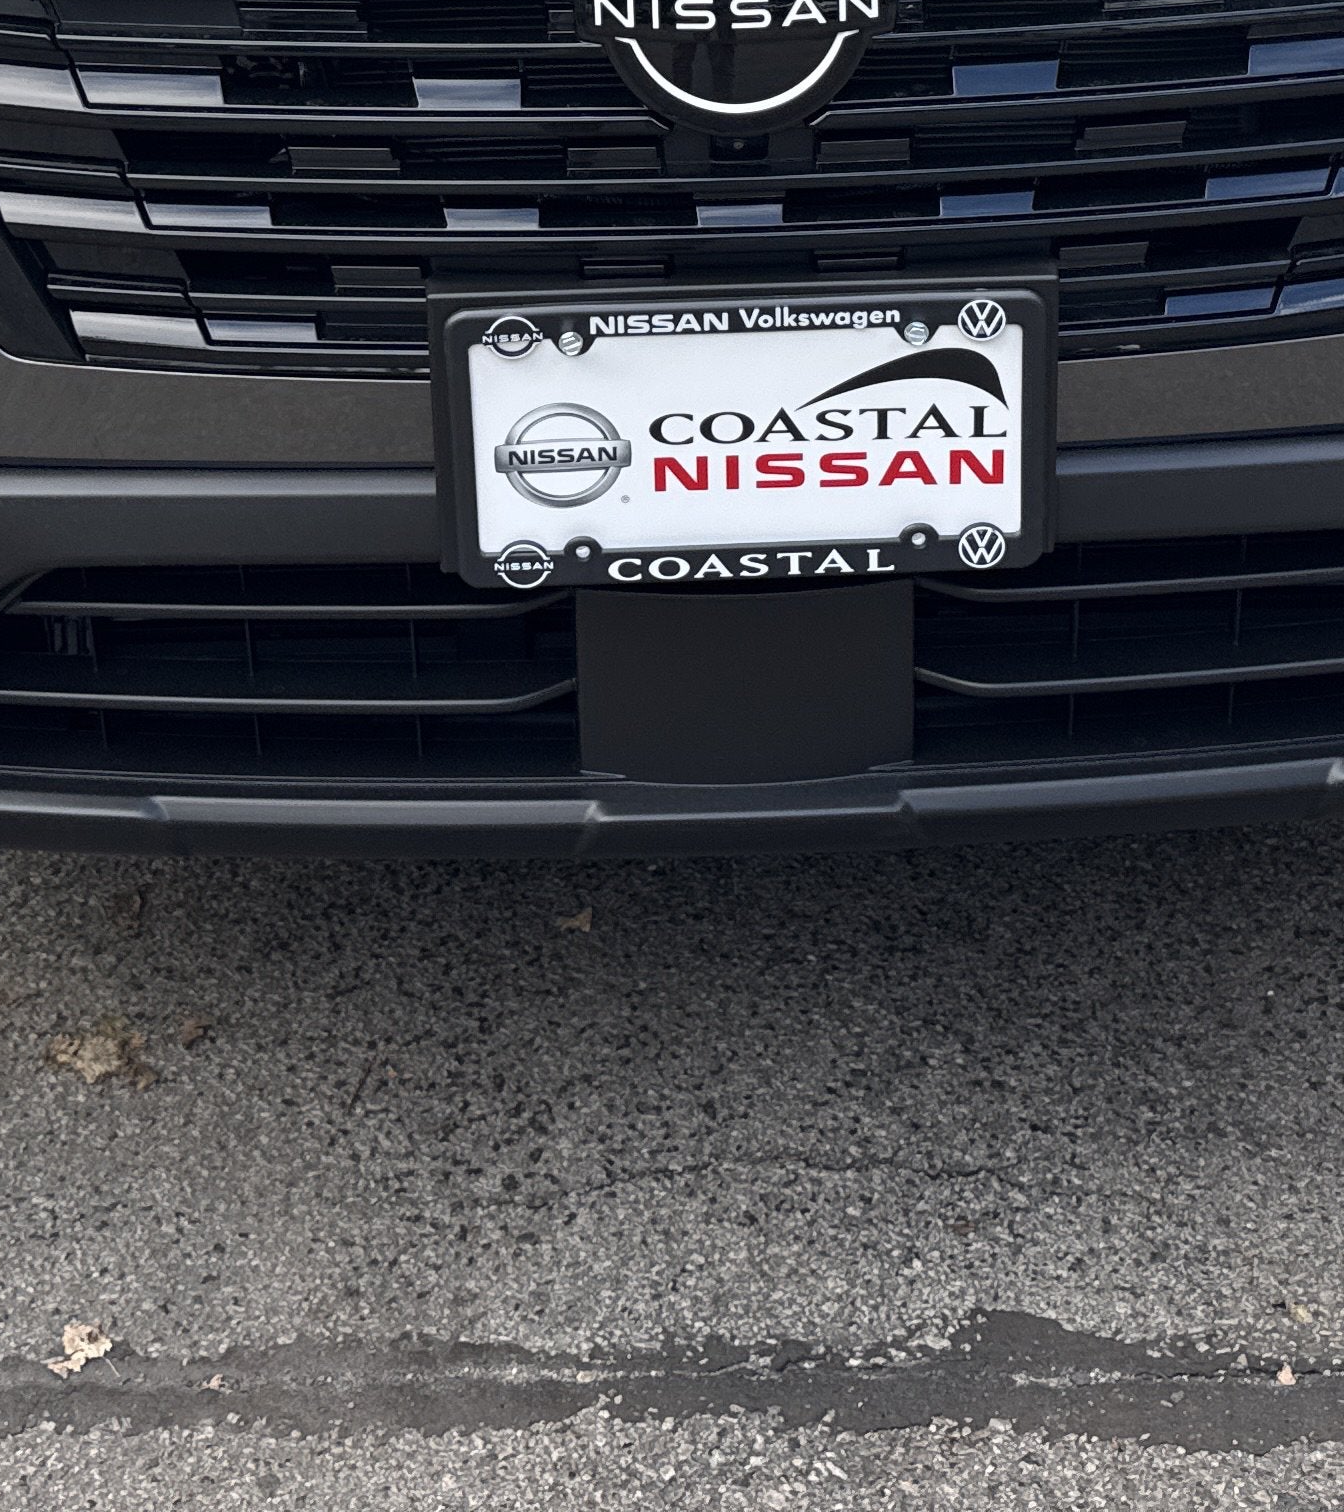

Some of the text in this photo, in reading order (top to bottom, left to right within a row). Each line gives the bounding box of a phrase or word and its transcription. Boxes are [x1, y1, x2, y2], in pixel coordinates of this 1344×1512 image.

[590, 306, 901, 336] NISSAN Volkswagen
[482, 329, 543, 345] NISSAN
[649, 403, 1008, 446] COASTAL
[508, 445, 619, 466] NISSAN
[653, 449, 1005, 492] NISSAN
[493, 558, 555, 573] NISSAN
[608, 548, 896, 582] COASTAL
